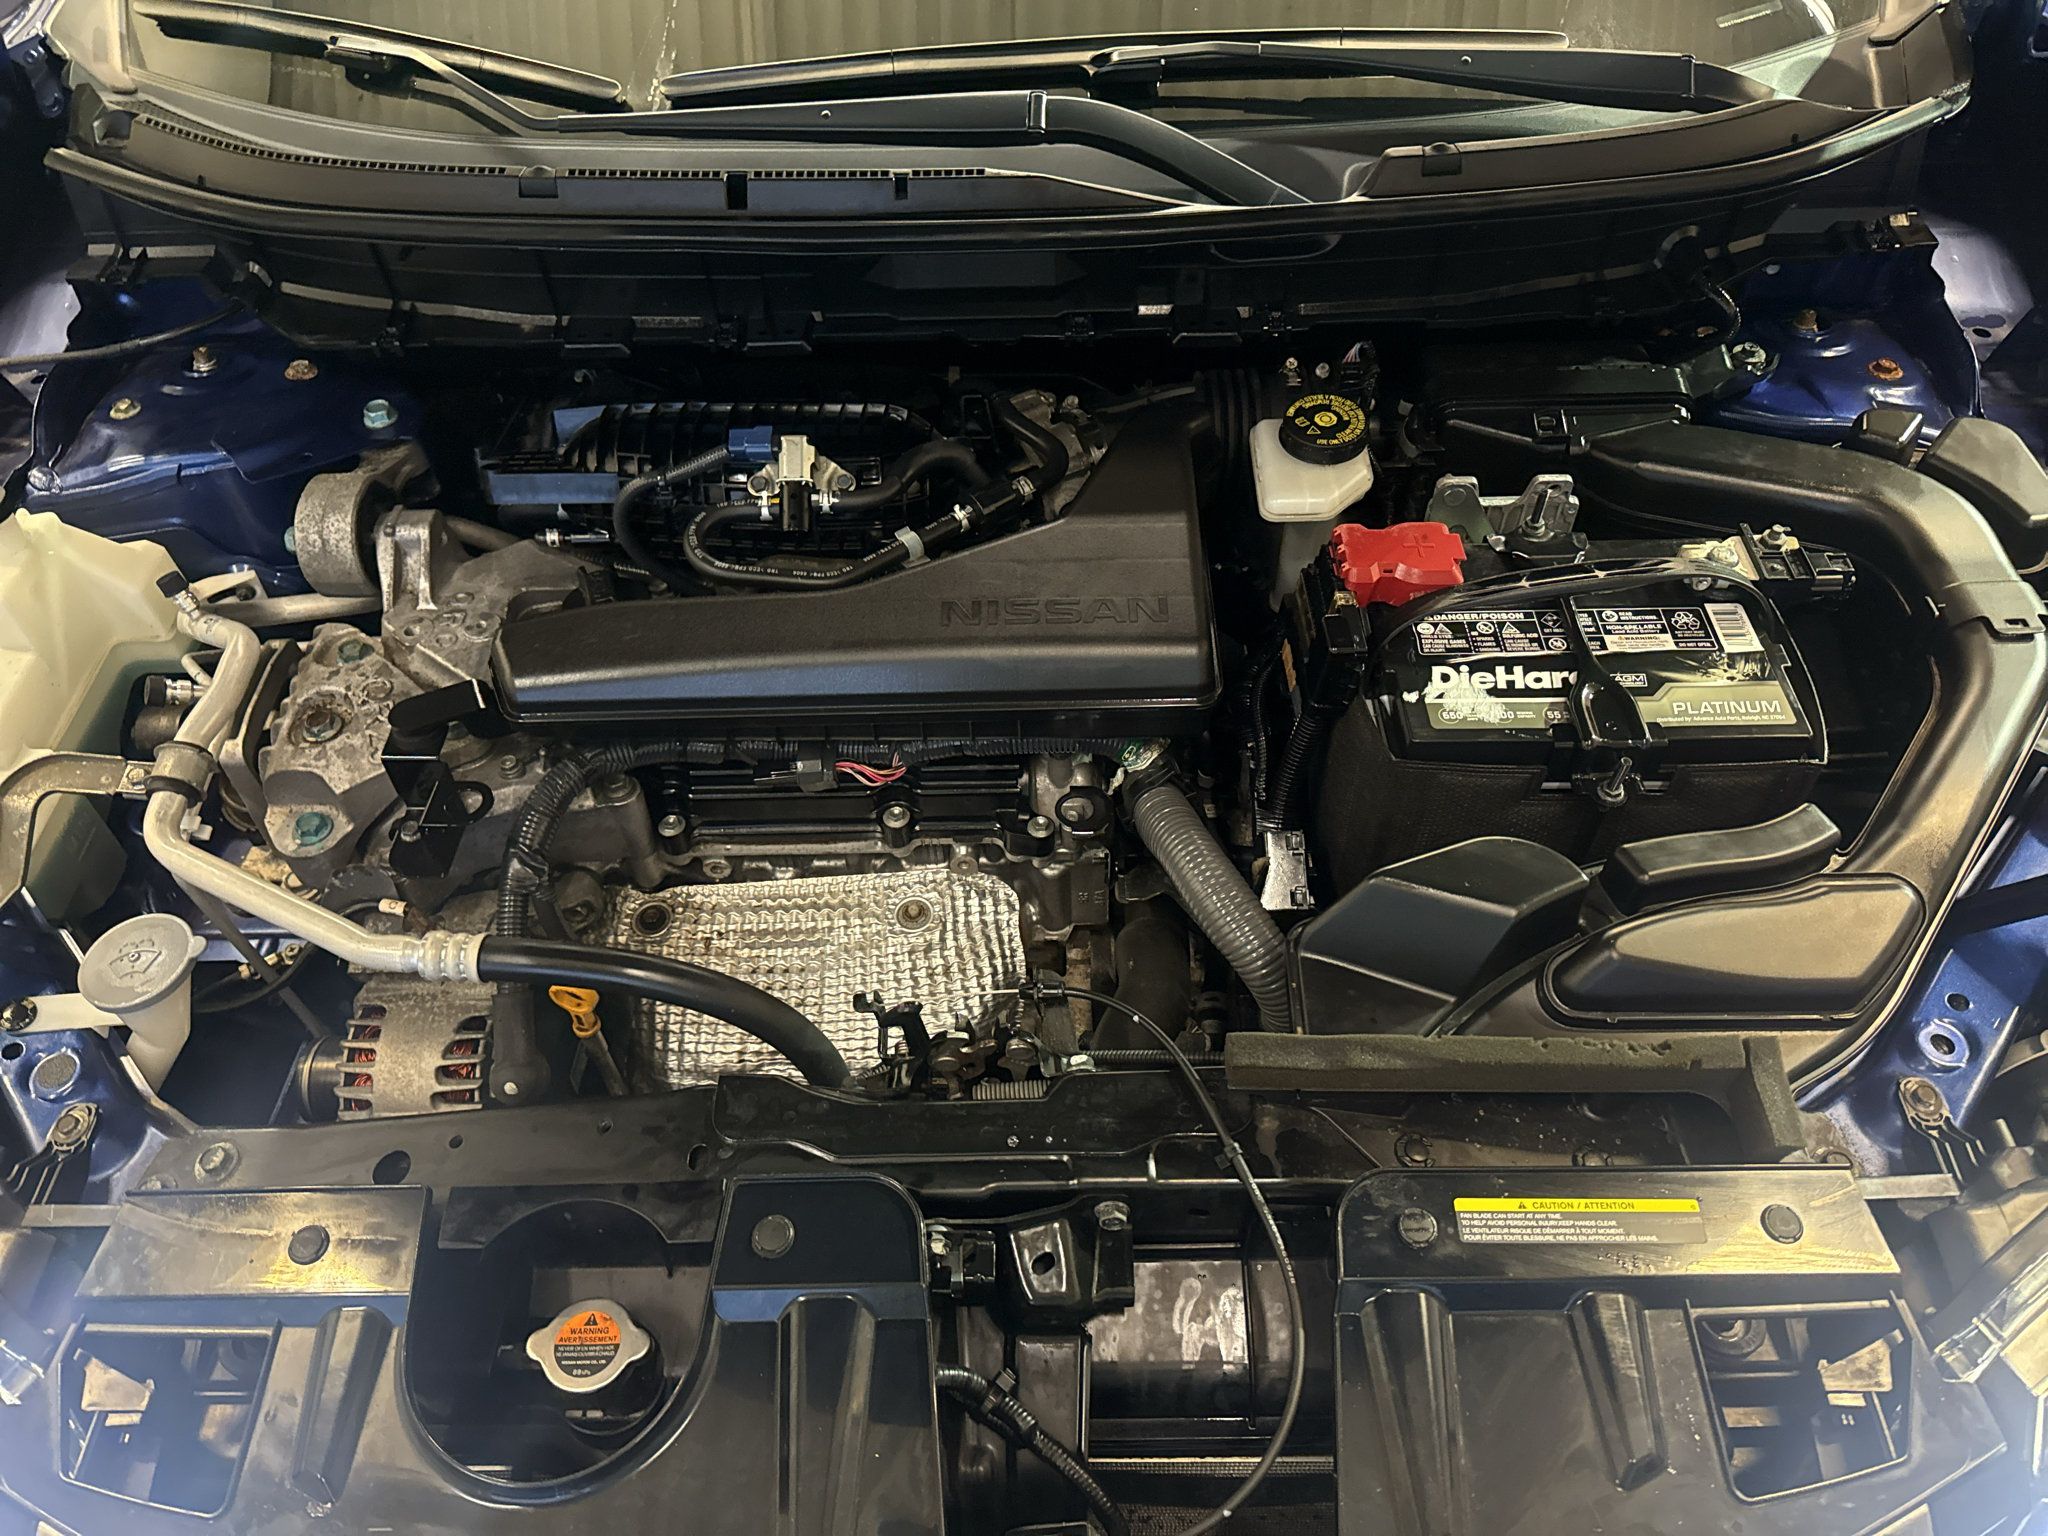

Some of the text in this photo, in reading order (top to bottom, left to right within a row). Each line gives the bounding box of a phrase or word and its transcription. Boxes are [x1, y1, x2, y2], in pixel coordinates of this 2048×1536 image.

[940, 596, 1169, 626] NISSAN
[1673, 700, 1782, 714] PLATINUM
[1532, 1201, 1574, 1209] CAUTION
[1584, 1201, 1635, 1209] ATTENTION
